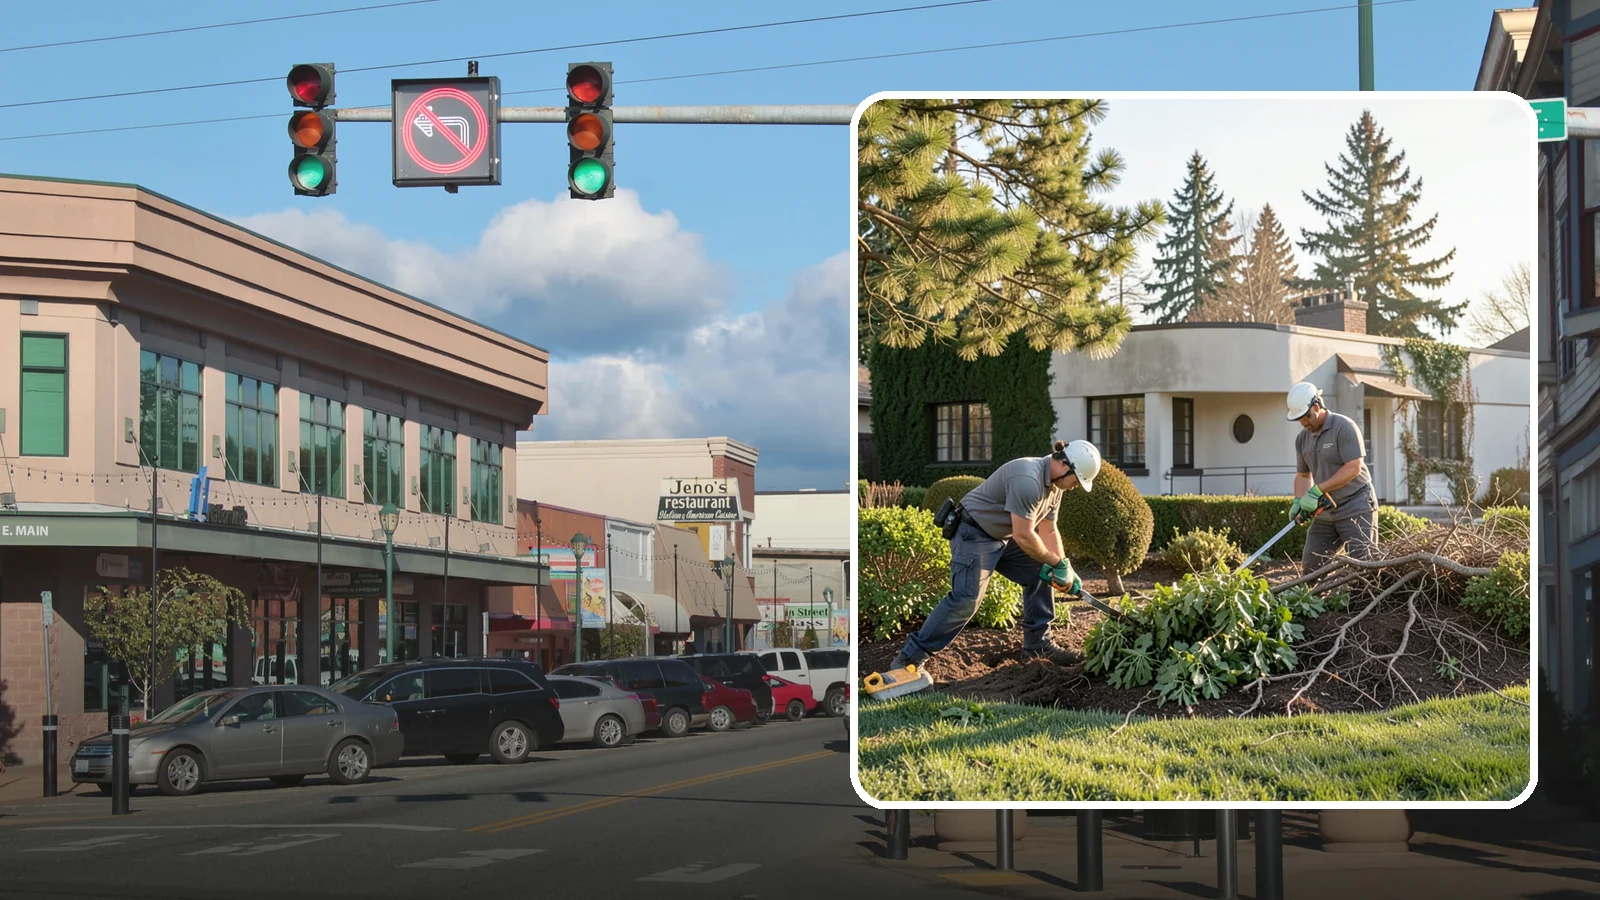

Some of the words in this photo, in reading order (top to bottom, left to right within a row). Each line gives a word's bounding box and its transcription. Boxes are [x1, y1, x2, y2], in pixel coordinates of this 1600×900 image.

[670, 480, 727, 494] Jeno's
[665, 496, 731, 509] restaurant
[659, 510, 682, 520] Italian
[686, 510, 715, 519] American
[715, 510, 737, 519] Cuisine
[2, 525, 13, 536] E.
[15, 525, 49, 536] MAIN
[797, 607, 828, 617] Street
